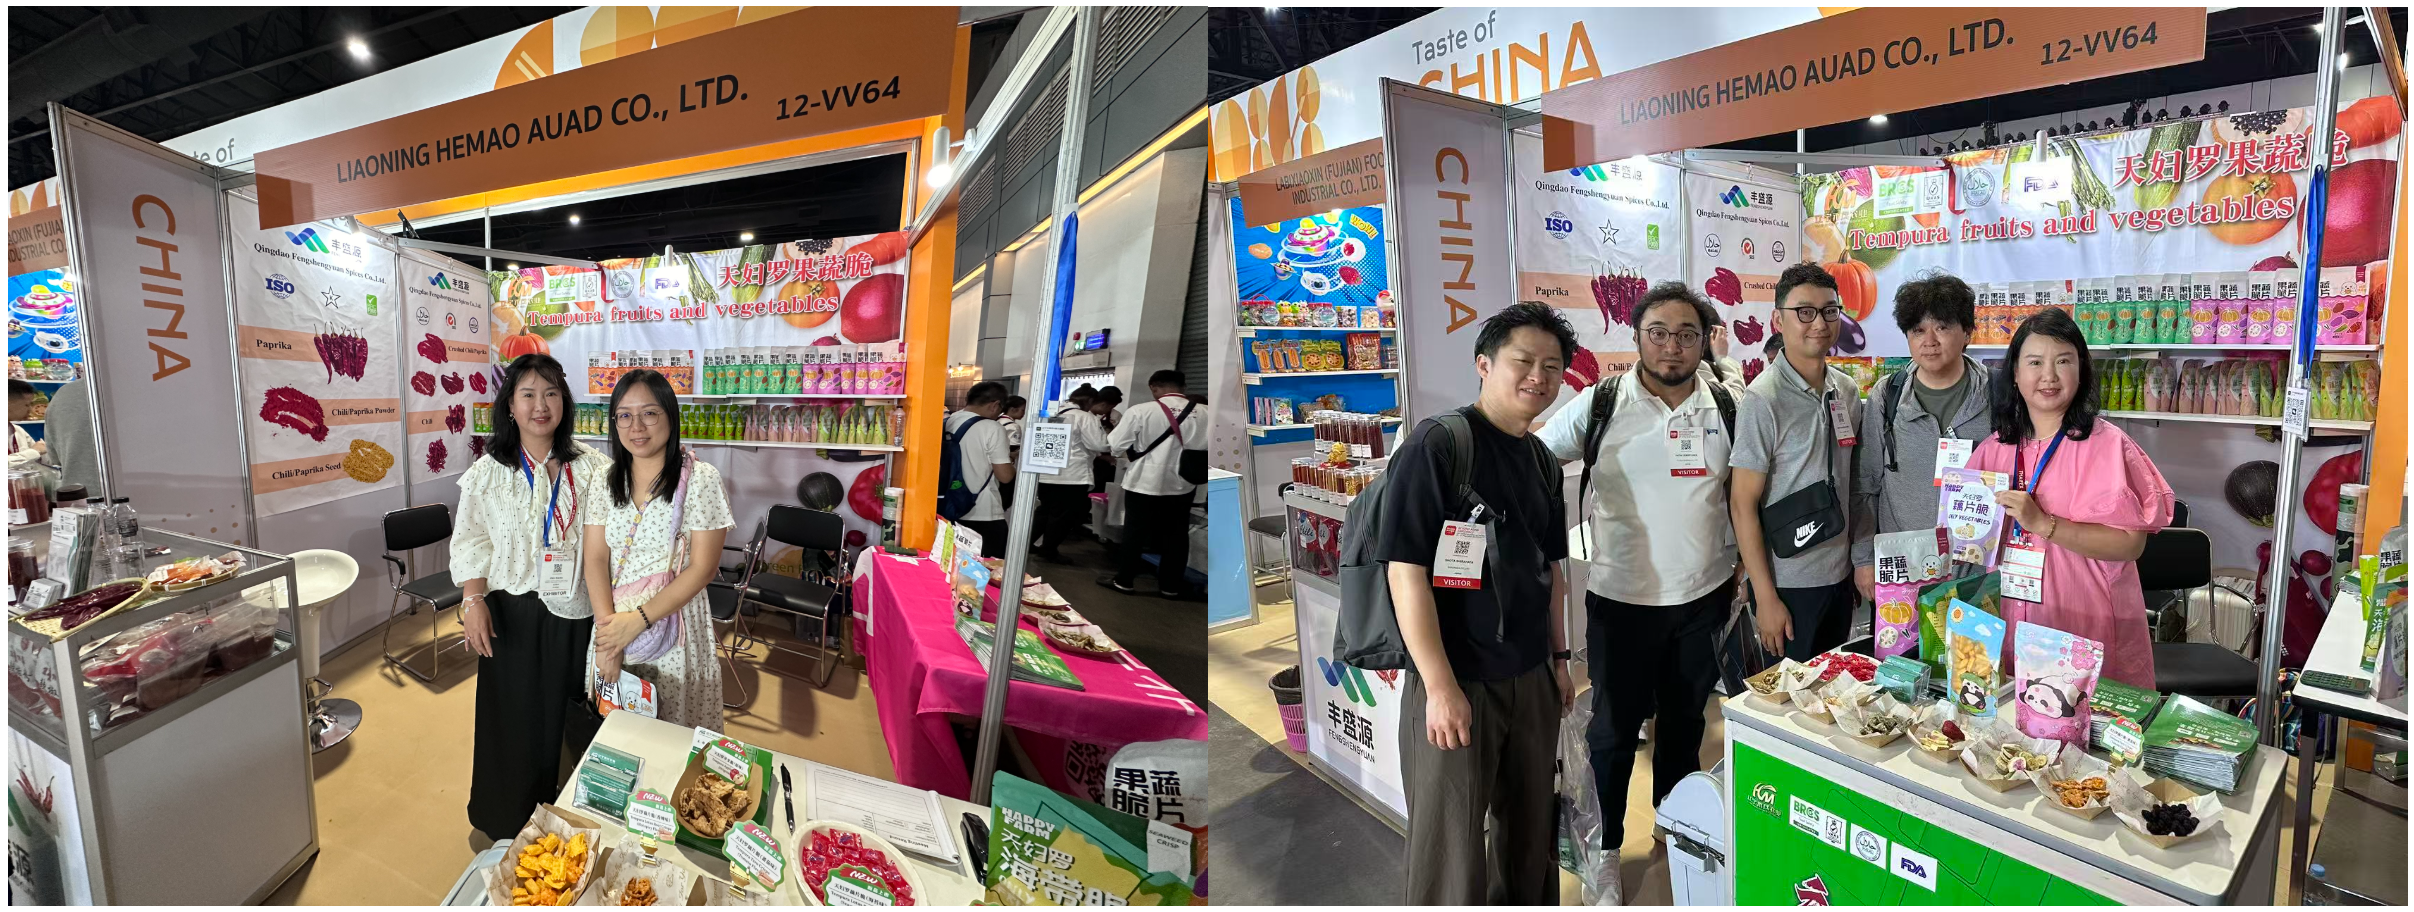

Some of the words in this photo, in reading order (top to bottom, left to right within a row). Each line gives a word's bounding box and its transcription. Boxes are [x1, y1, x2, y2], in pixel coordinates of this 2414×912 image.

[1412, 29, 1468, 64] Taste
[1474, 10, 1496, 43] of
[2040, 21, 2158, 66] 12-VV64
[1620, 85, 1710, 125] LIAONING
[1716, 65, 1797, 104] HEMAO
[1804, 47, 1876, 87] AUAD
[1883, 36, 1938, 69] CO.,
[1949, 18, 2014, 57] LTD.
[776, 76, 901, 120] 12-VV64
[337, 143, 430, 183] LIAONING
[436, 123, 520, 163] HEMAO
[527, 105, 602, 144] AUAD
[611, 94, 668, 126] CO.,
[679, 74, 748, 113] LTD.
[216, 138, 235, 163] of
[1275, 167, 1323, 191] LABIXIAOXIN
[1325, 157, 1362, 182] (FUJIAN)
[1292, 183, 1340, 205] INDUSTRIAL
[1340, 179, 1359, 196] CO.,
[1360, 174, 1382, 192] LTD.
[1535, 180, 1569, 194] Qingdao
[1570, 186, 1624, 204] Fengshengyuan
[1750, 191, 1773, 206] 丰盛源
[1545, 216, 1573, 234] ISO
[1696, 208, 1720, 220] Qingdao
[1850, 225, 1949, 250] Tempura
[1960, 216, 2033, 241] fruits
[2043, 209, 2096, 235] and
[2108, 194, 2294, 231] vegetables
[1435, 147, 1478, 335] CHINA
[254, 242, 290, 260] Qingdao
[292, 254, 345, 273] Fengshengyuan
[345, 266, 364, 279] Spices
[718, 251, 874, 289] 天妇罗果蔬脆
[132, 194, 191, 381] CHINA
[265, 277, 295, 295] ISO
[1535, 286, 1569, 298] Paprika
[1744, 282, 1765, 290] Crushed
[527, 310, 602, 328] Tempura
[610, 304, 663, 321] fruits
[669, 302, 706, 320] and
[715, 294, 839, 318] vegetables
[256, 338, 292, 350] Paprika
[331, 407, 374, 418] Chili/Paprika
[375, 406, 396, 415] Powder
[272, 465, 324, 481] Chili/Paprika
[325, 462, 342, 472] Seed
[1796, 520, 1815, 540] NIKE
[1959, 515, 1991, 526] VEGETABLES
[759, 560, 794, 573] reen
[1879, 556, 1908, 569] 果蔬
[1443, 579, 1471, 587] VISITOR
[1879, 569, 1909, 582] 脆片
[1328, 700, 1374, 750] 丰盛源
[1328, 729, 1375, 764] FENGSHENGYUAN
[1113, 767, 1182, 798] 果蔬
[1112, 788, 1185, 823] 脆片
[1002, 807, 1056, 833] HAPPY
[1003, 815, 1051, 841] FARM
[1001, 828, 1076, 871] 天妇罗
[1148, 829, 1189, 846] SEAWEED
[1156, 838, 1180, 849] CRISP
[1900, 857, 1927, 879] FDA
